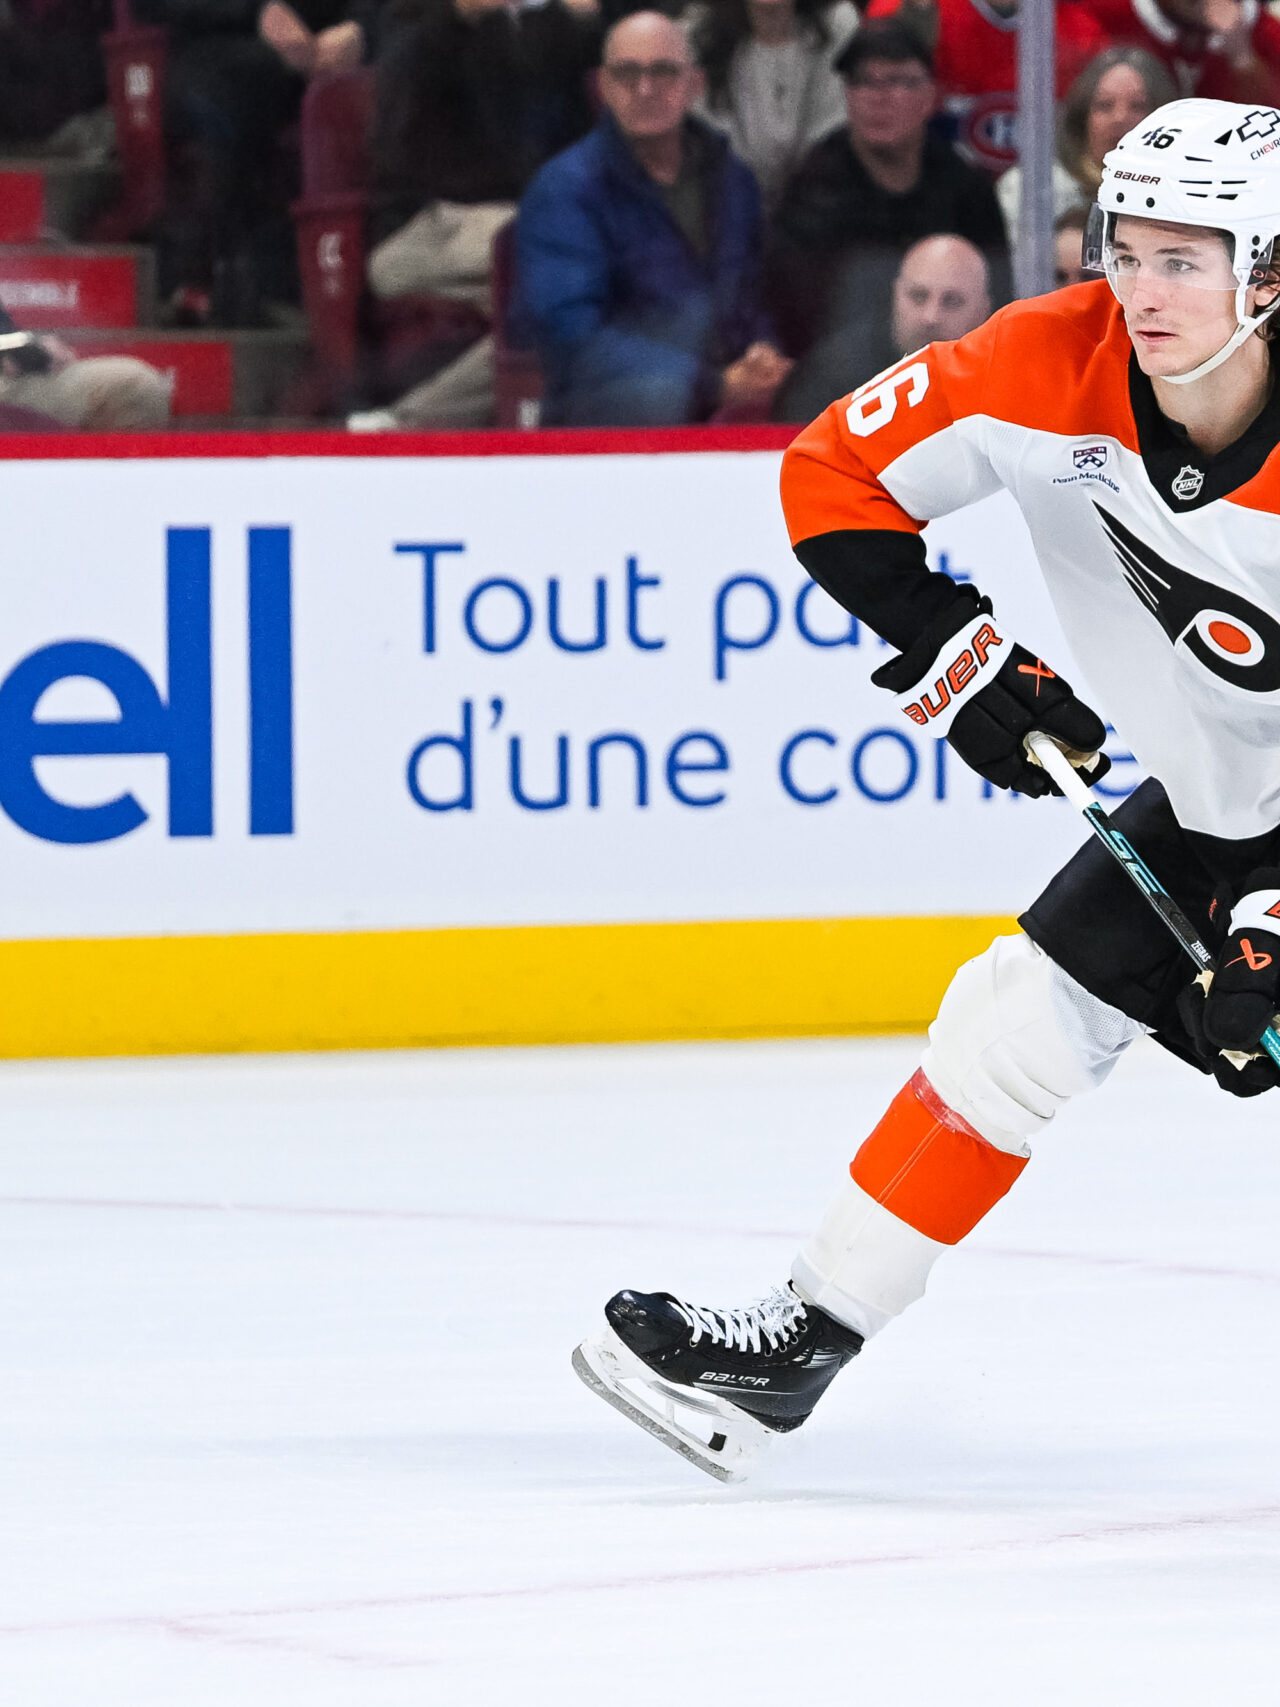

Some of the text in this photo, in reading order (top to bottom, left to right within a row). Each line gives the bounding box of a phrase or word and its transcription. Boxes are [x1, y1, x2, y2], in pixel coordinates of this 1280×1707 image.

[1141, 125, 1183, 149] 46
[846, 343, 930, 437] 6
[1052, 471, 1121, 494] Penn Medicine
[394, 541, 667, 655] Tout
[405, 697, 732, 813] d'une
[1190, 940, 1212, 964] ZEGRAS
